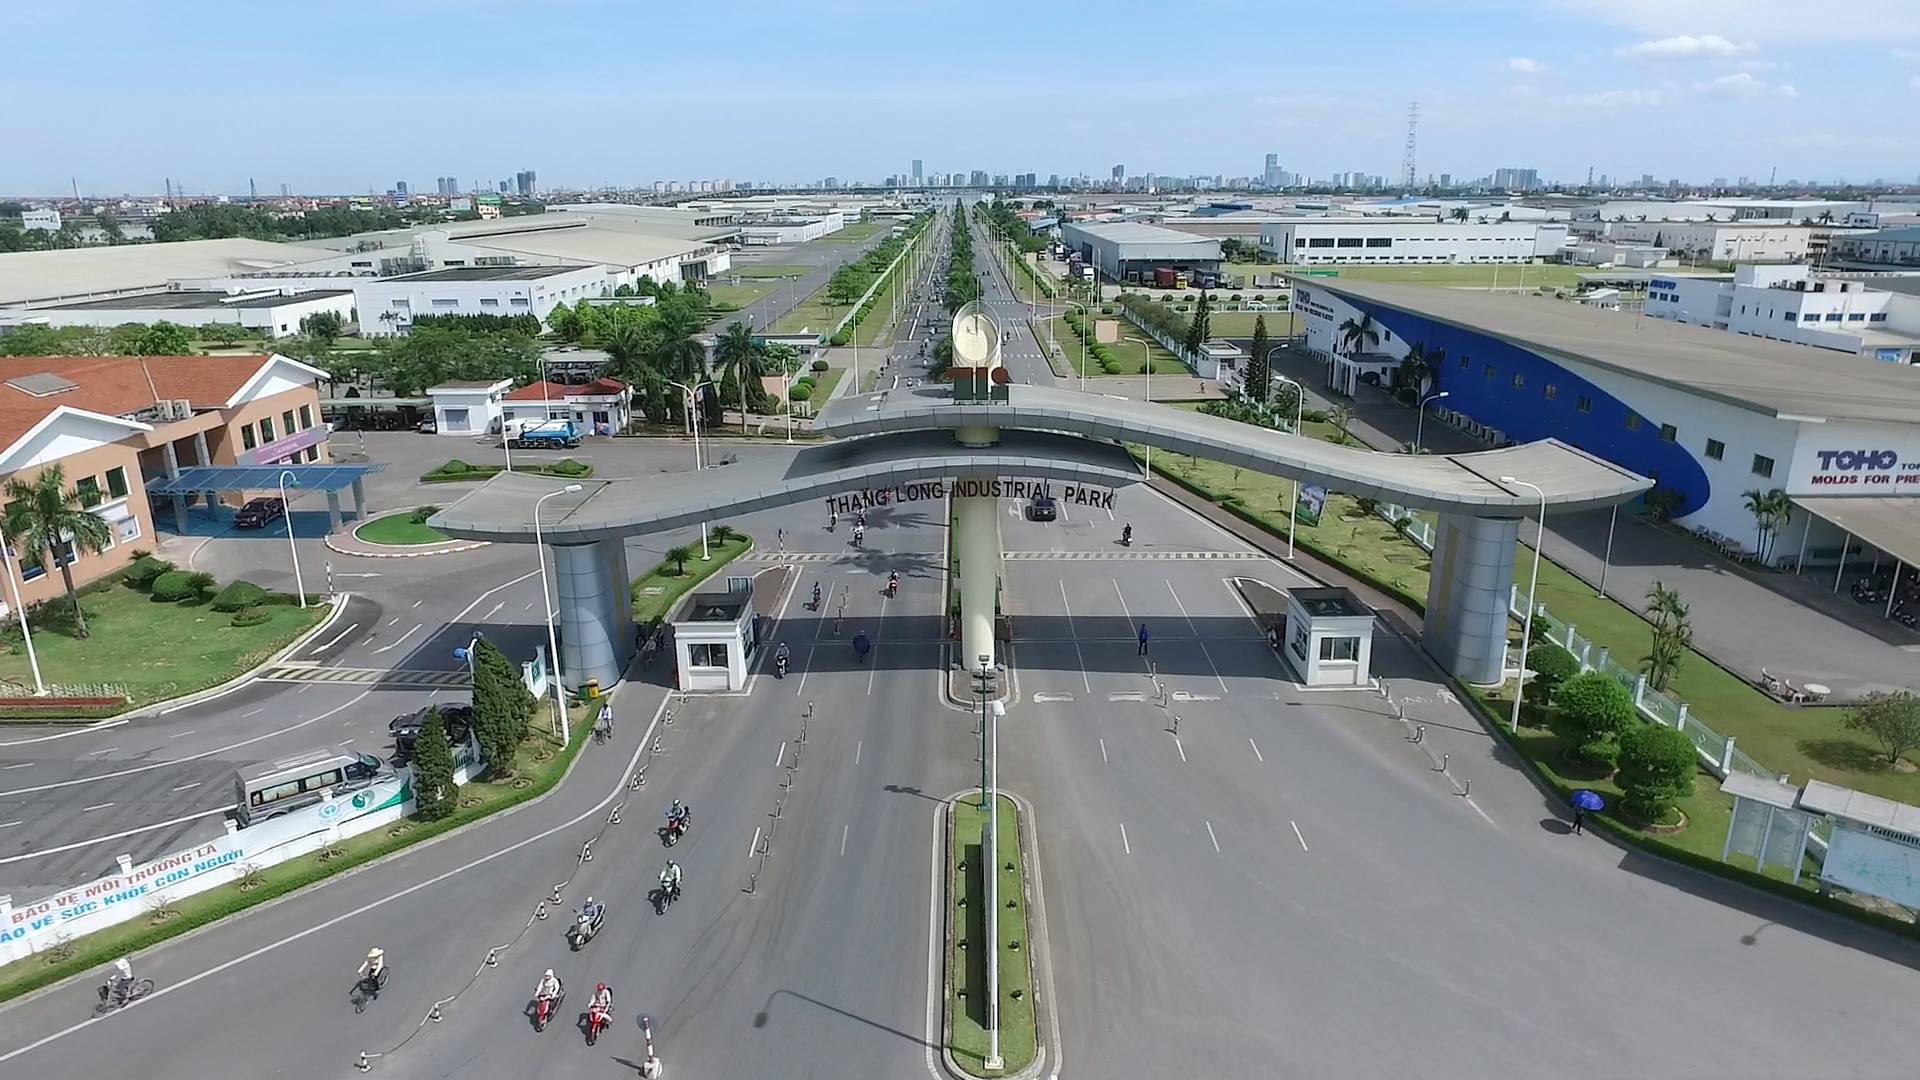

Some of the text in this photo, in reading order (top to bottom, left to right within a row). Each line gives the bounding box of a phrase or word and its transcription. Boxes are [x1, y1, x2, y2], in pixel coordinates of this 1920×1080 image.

[1817, 450, 1898, 471] TOHO
[1811, 475, 1858, 485] MOLDS
[1864, 475, 1890, 484] FOR
[826, 480, 1116, 515] THANG LONG INDUSTRIAL PARK
[155, 868, 190, 887] CON
